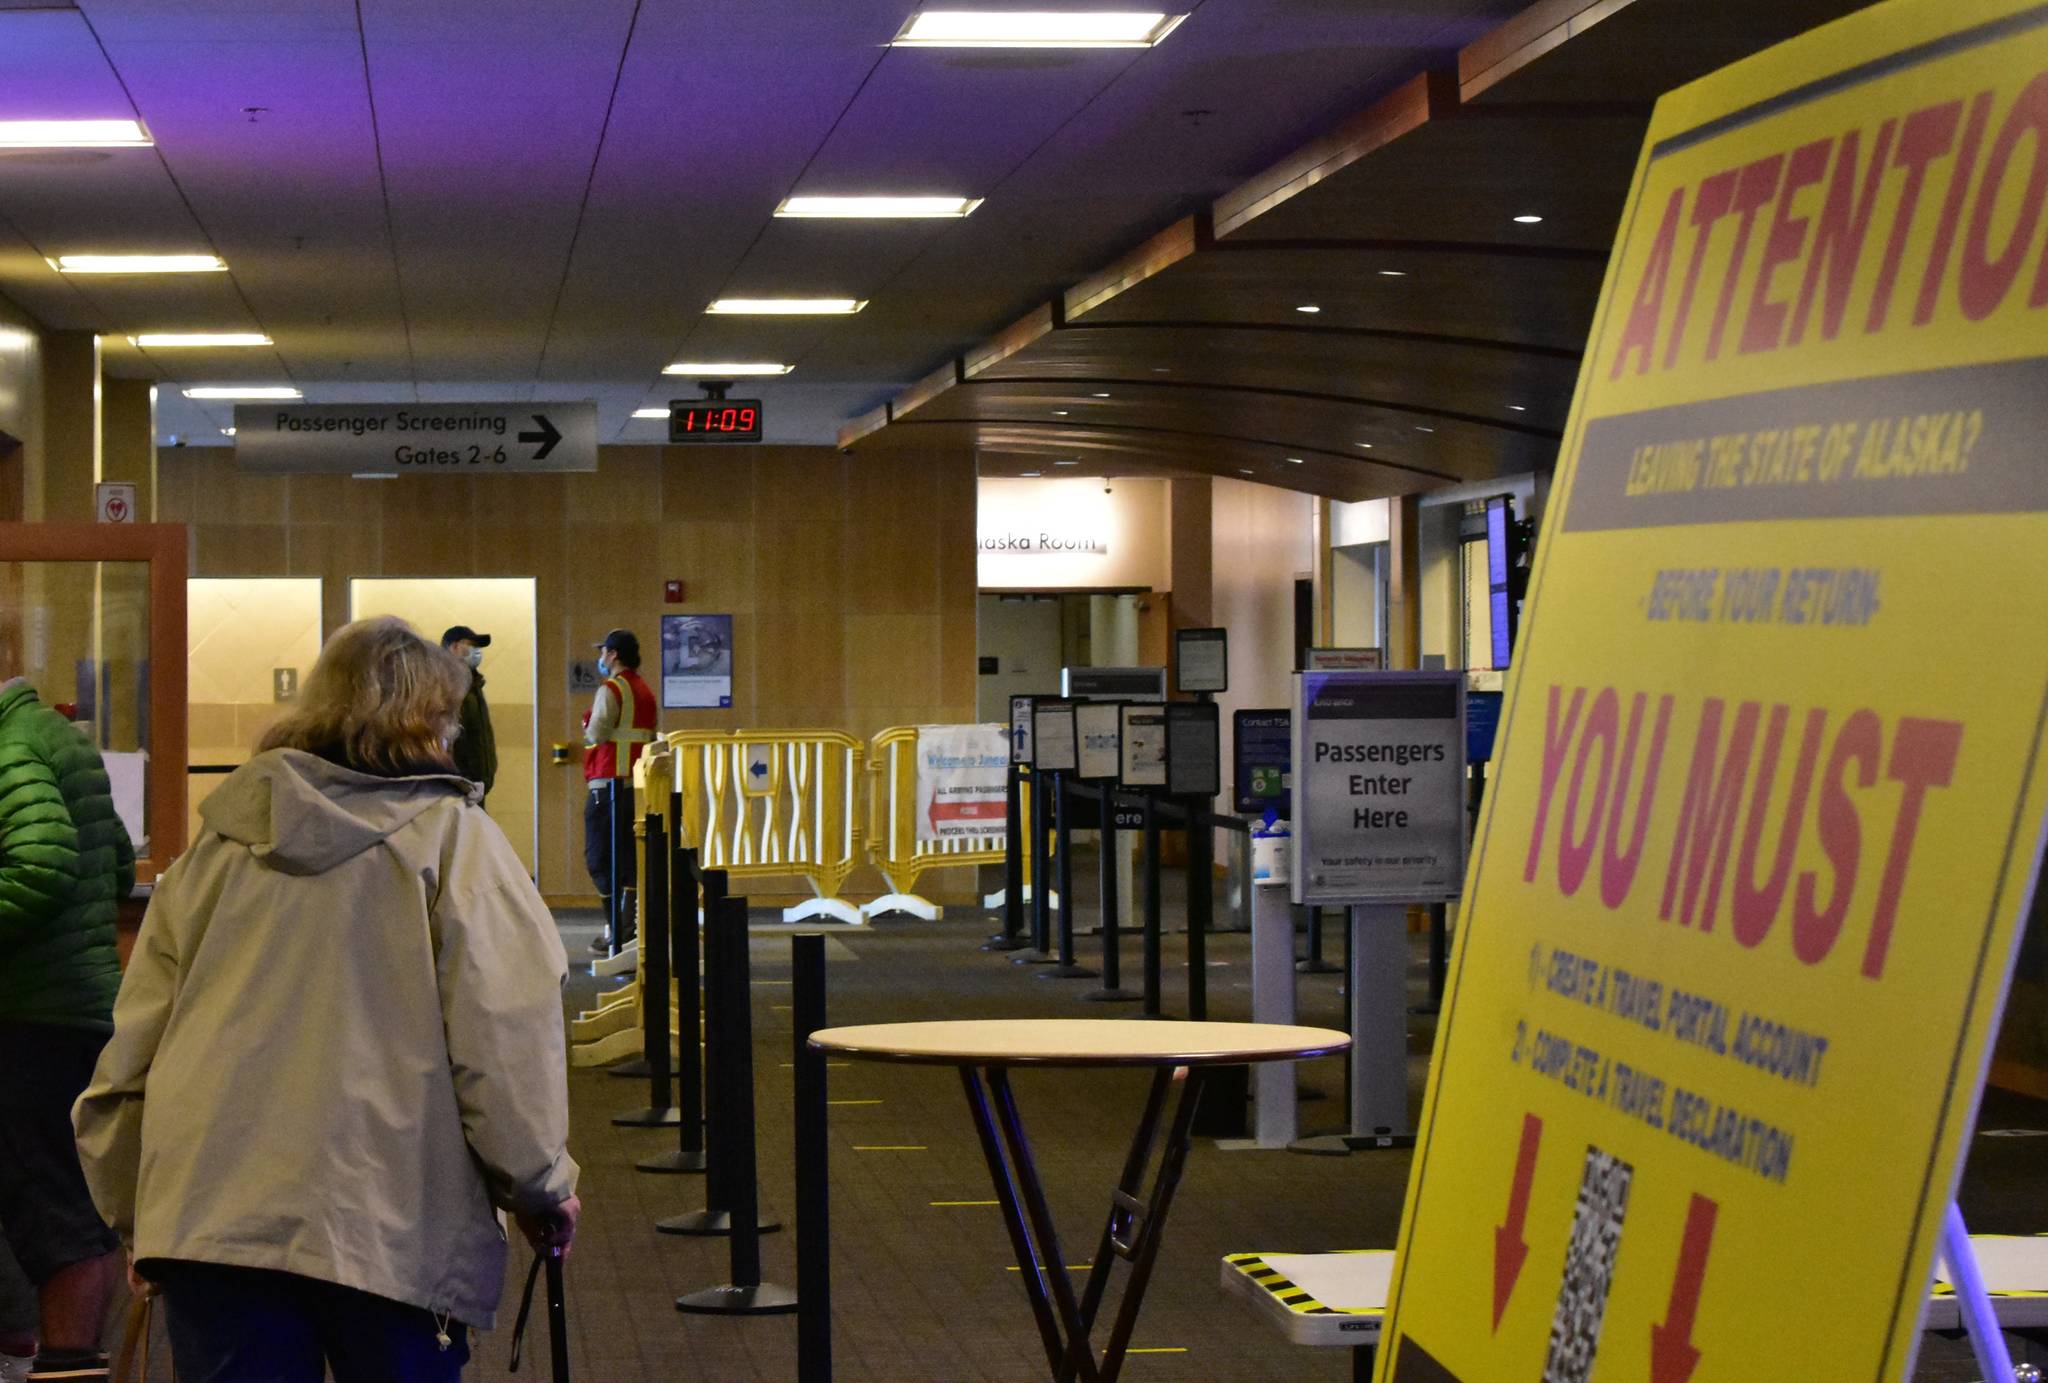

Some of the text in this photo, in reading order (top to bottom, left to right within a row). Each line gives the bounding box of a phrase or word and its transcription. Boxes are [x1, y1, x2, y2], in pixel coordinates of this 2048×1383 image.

[1609, 66, 2048, 383] ATTENTIO
[275, 411, 507, 436] Passenger Screening
[686, 409, 755, 432] 11:09
[395, 445, 507, 466] Gates 2-6
[1626, 408, 1984, 497] LEAVING THE STATE OF ALASKA?
[977, 531, 1096, 550] laska Room
[1721, 568, 1781, 624] YOUR
[1314, 742, 1445, 766] Passengers
[1349, 774, 1412, 796] Enter
[1115, 811, 1142, 824] ere
[1353, 807, 1409, 829] Here
[1523, 684, 1965, 982] YOU MUST
[1321, 857, 1342, 866] Your
[1344, 856, 1373, 867] safety
[1402, 855, 1438, 867] priority
[1547, 947, 1599, 1007] CREATE
[1608, 967, 1664, 1032] TRAVEL
[1665, 988, 1730, 1057] PORTAL
[1731, 1009, 1831, 1090] ACCOUNT
[1532, 1028, 1600, 1098] COMPLETE
[1610, 1060, 1667, 1131] TRAVEL
[1667, 1086, 1796, 1186] DECLARATION
